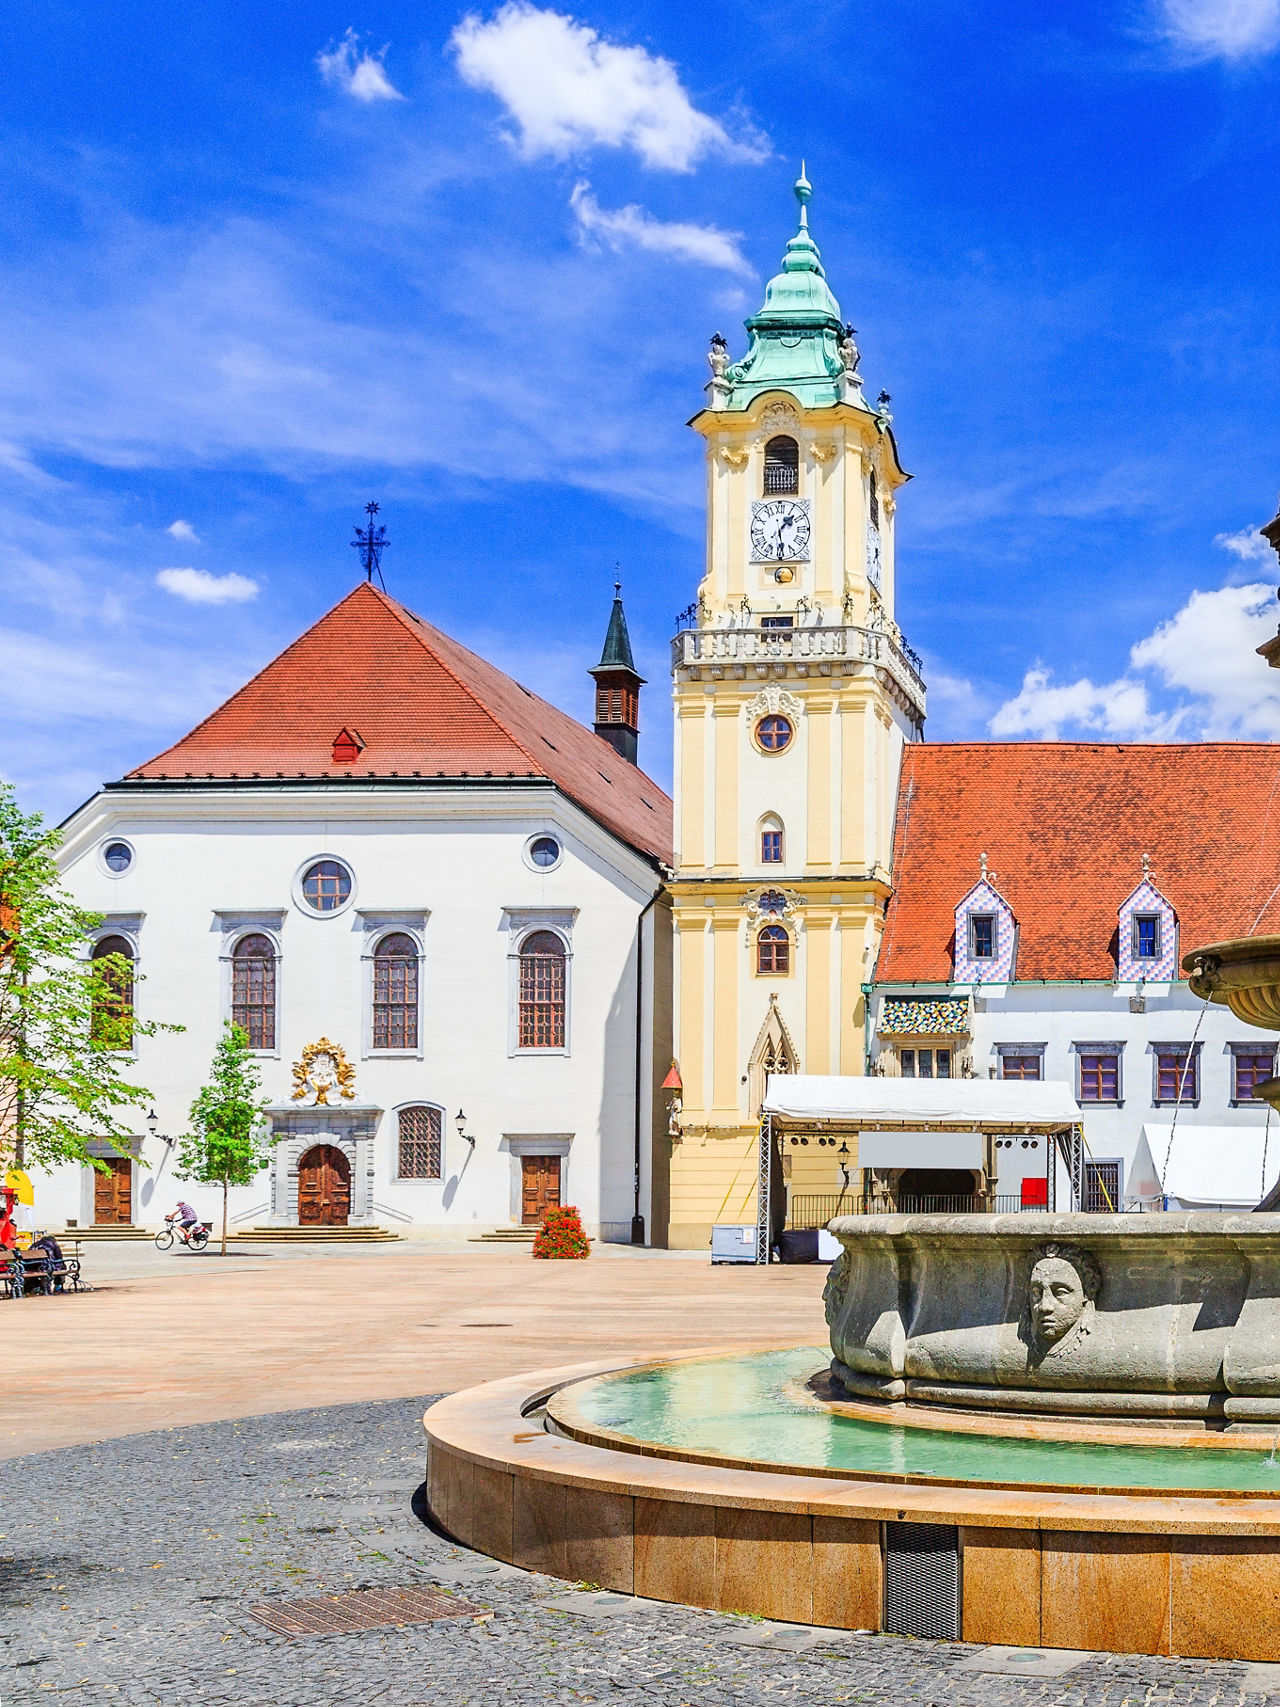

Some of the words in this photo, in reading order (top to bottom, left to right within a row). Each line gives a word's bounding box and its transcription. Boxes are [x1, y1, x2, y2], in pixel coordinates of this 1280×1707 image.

[765, 507, 774, 518] XI
[775, 505, 785, 514] XII
[757, 517, 766, 525] X
[794, 515, 803, 523] II
